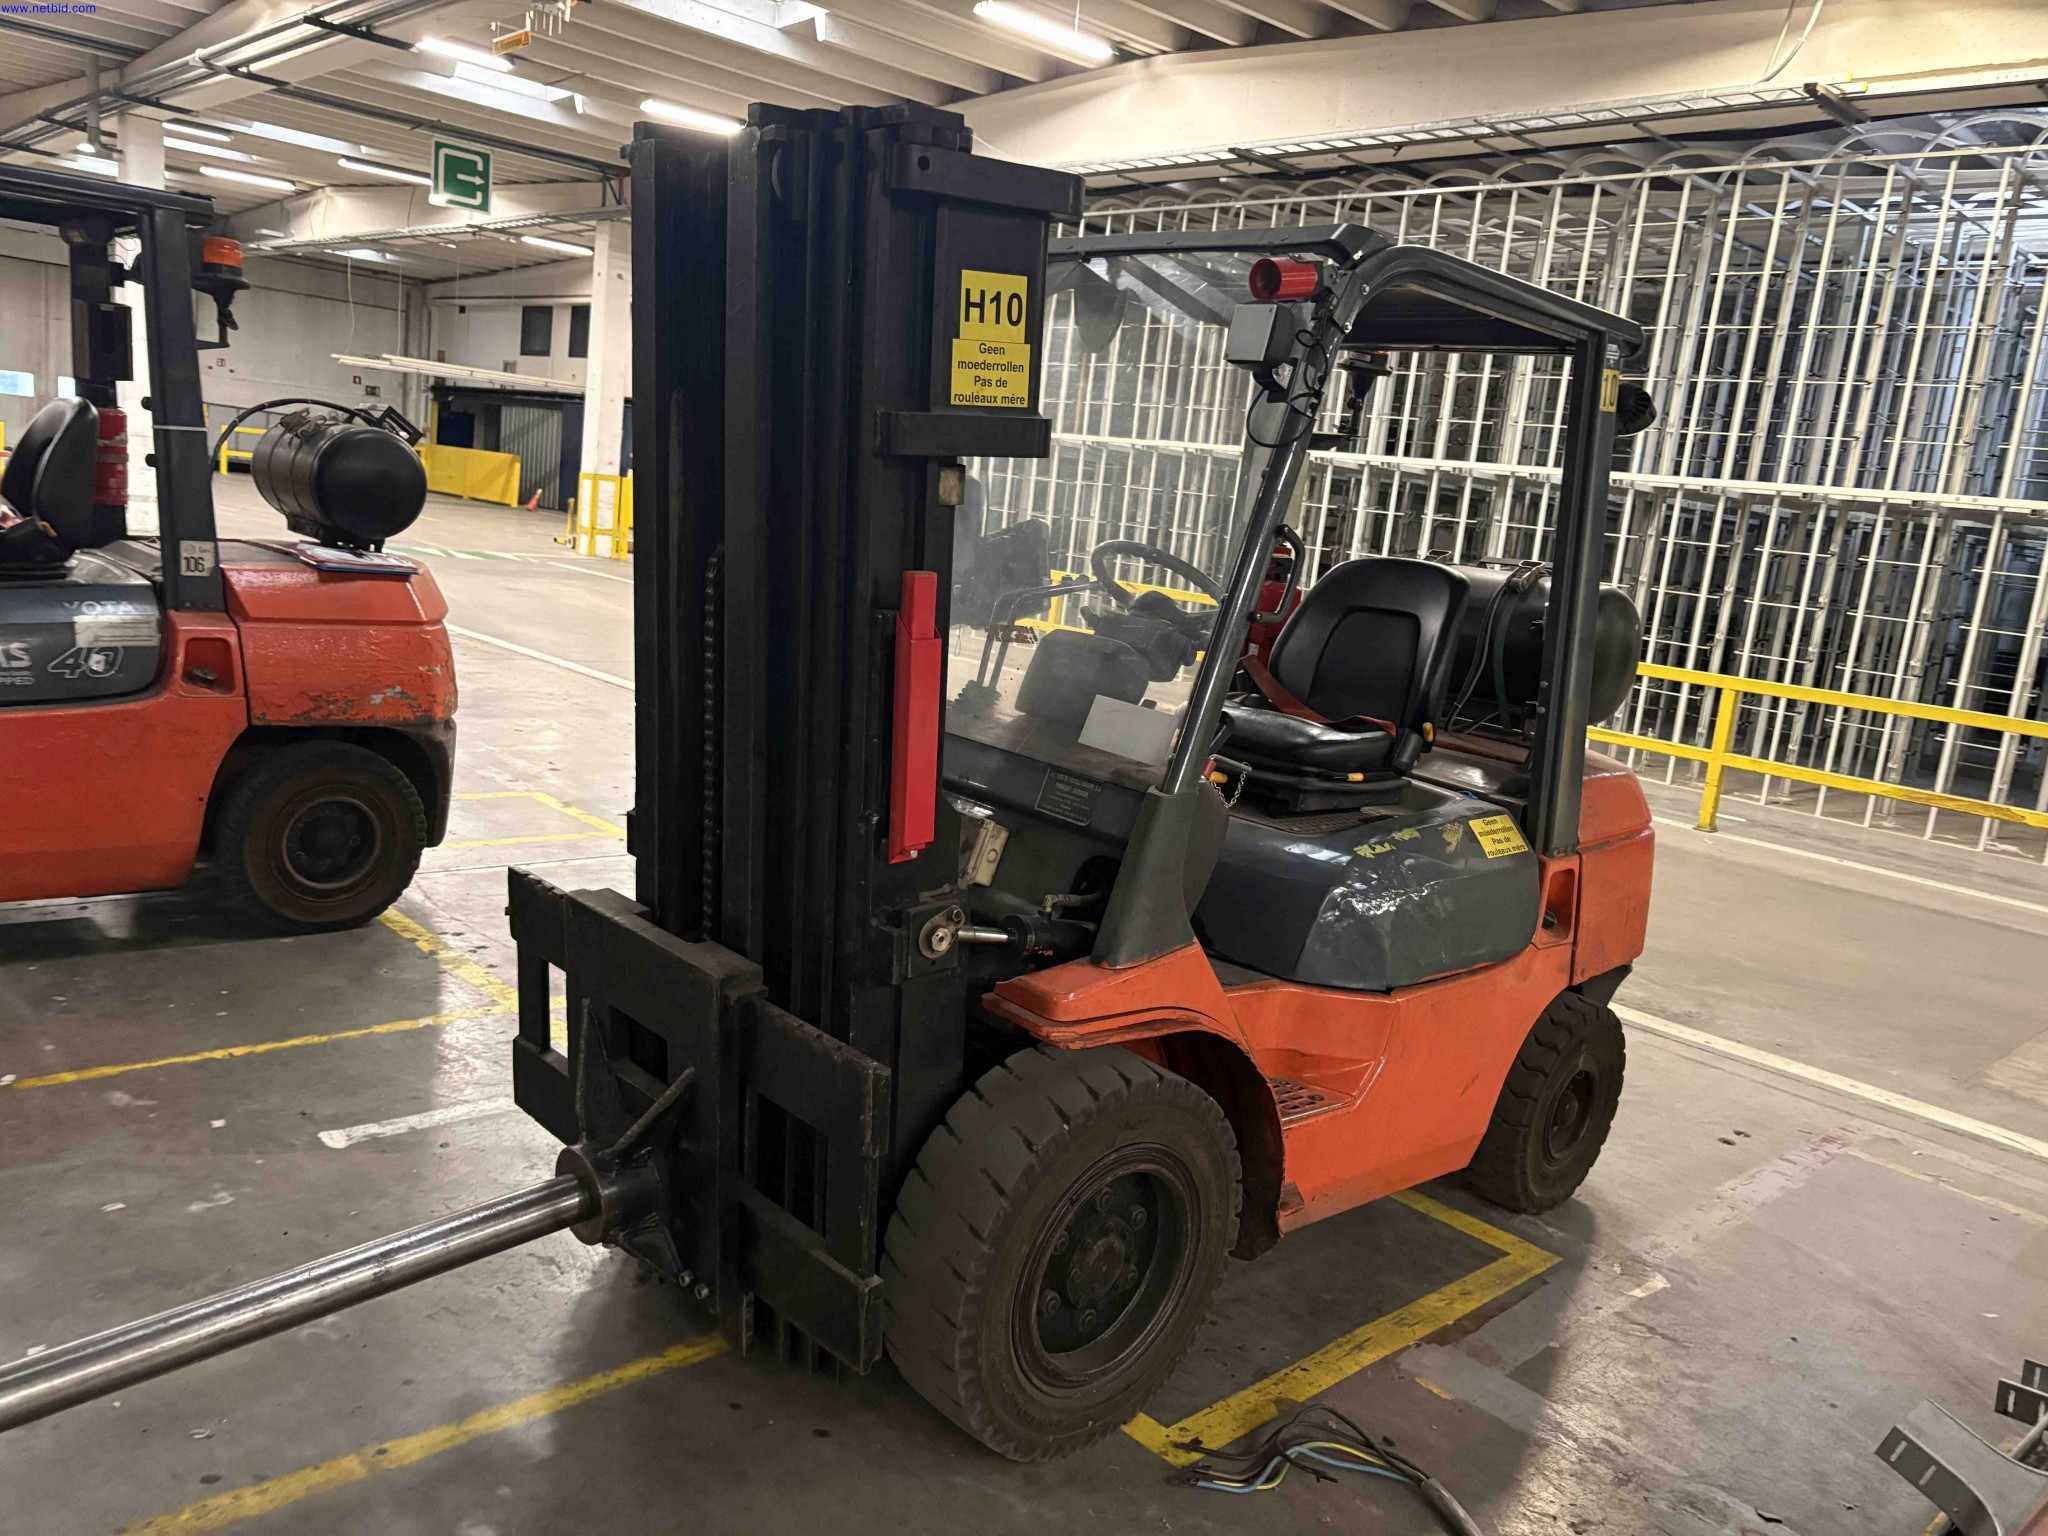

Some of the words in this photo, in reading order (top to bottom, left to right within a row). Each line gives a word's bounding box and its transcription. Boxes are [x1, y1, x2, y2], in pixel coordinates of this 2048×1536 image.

[965, 288, 1023, 327] H10
[979, 343, 1005, 355] Geen
[957, 360, 1024, 372] moederrollen
[974, 375, 992, 387] Pas
[995, 377, 1008, 388] de
[953, 391, 998, 404] rouleaux
[1478, 826, 1515, 837] moederrollen
[1491, 837, 1504, 845] Pas
